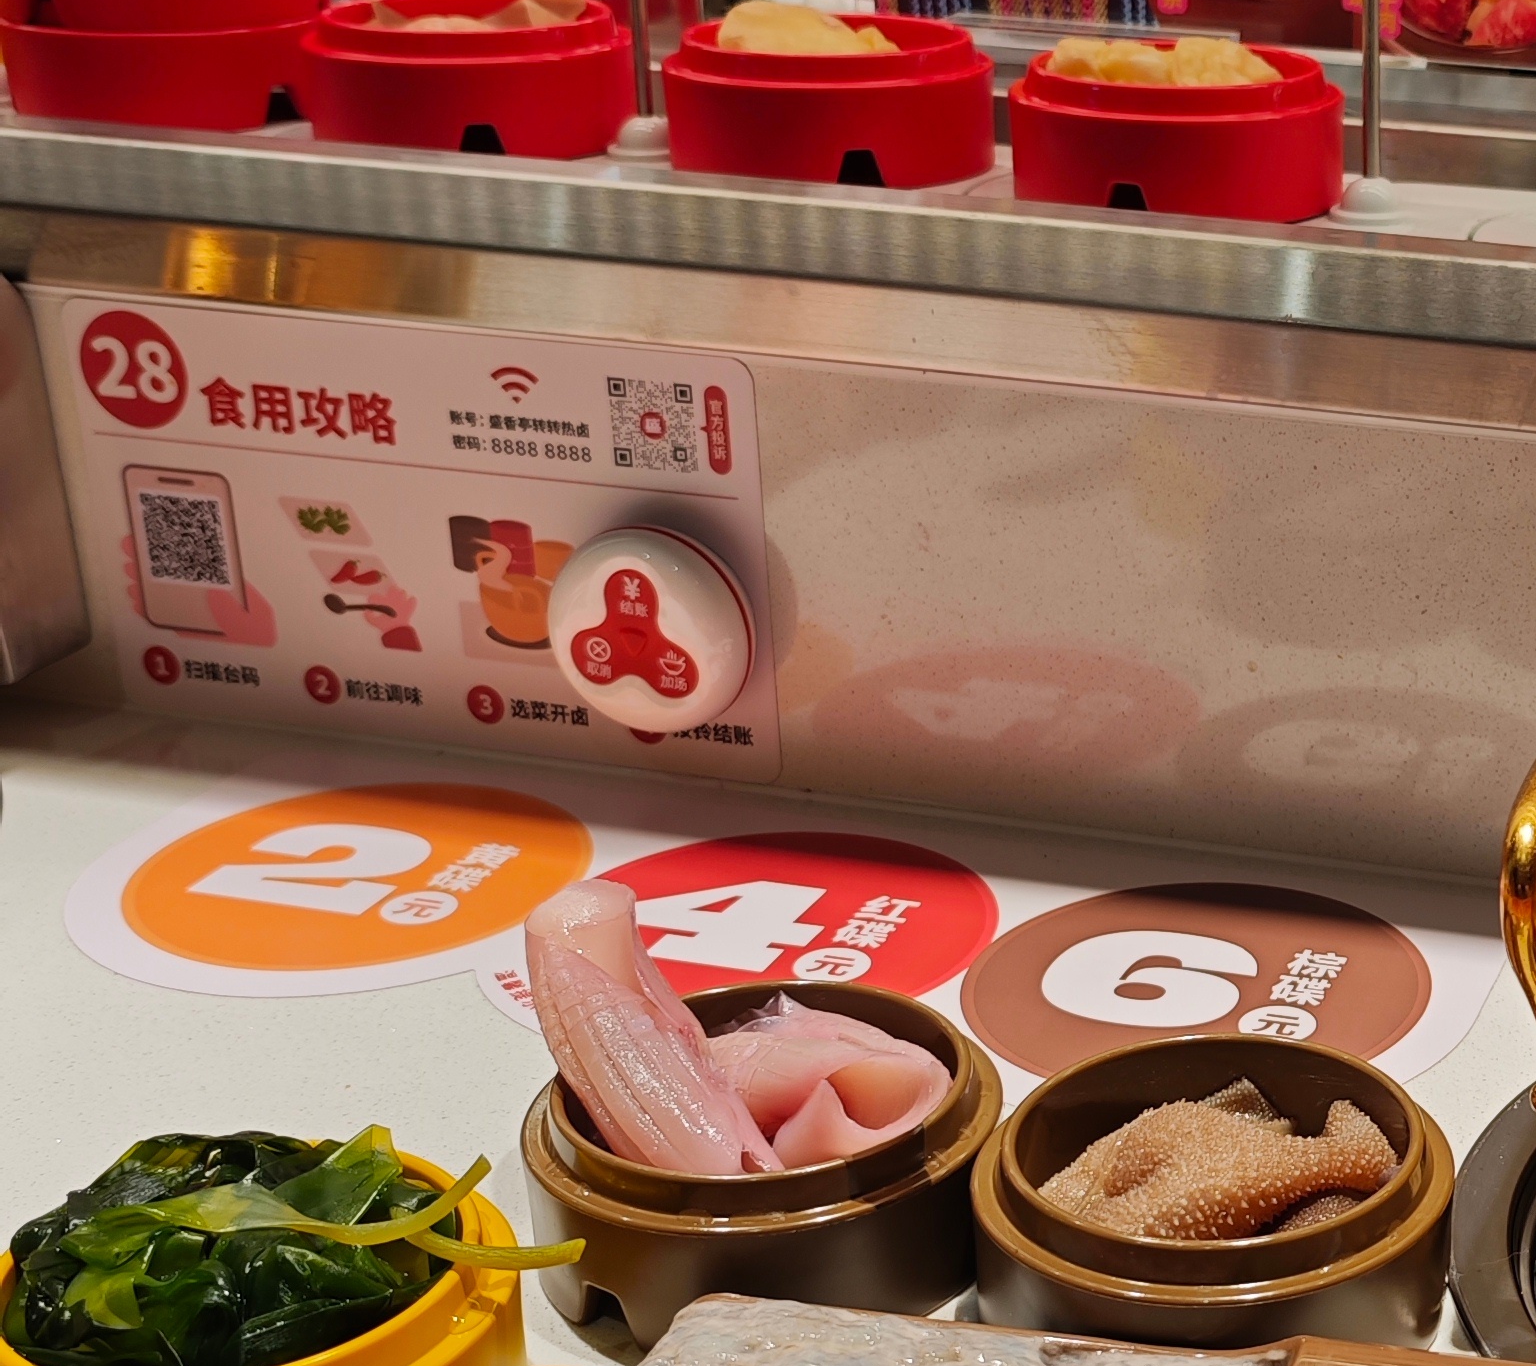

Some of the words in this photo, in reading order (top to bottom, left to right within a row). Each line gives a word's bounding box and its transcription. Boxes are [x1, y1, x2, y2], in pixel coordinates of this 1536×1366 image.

[90, 335, 179, 405] 28
[200, 376, 397, 446] 食用攻略
[544, 442, 592, 464] 8888
[511, 698, 590, 727] 选菜开卤
[186, 822, 432, 916] 2
[635, 880, 827, 973] 4
[832, 895, 922, 949] 红碟
[1040, 929, 1258, 1028] 6
[1269, 948, 1348, 1006] 棕碟
